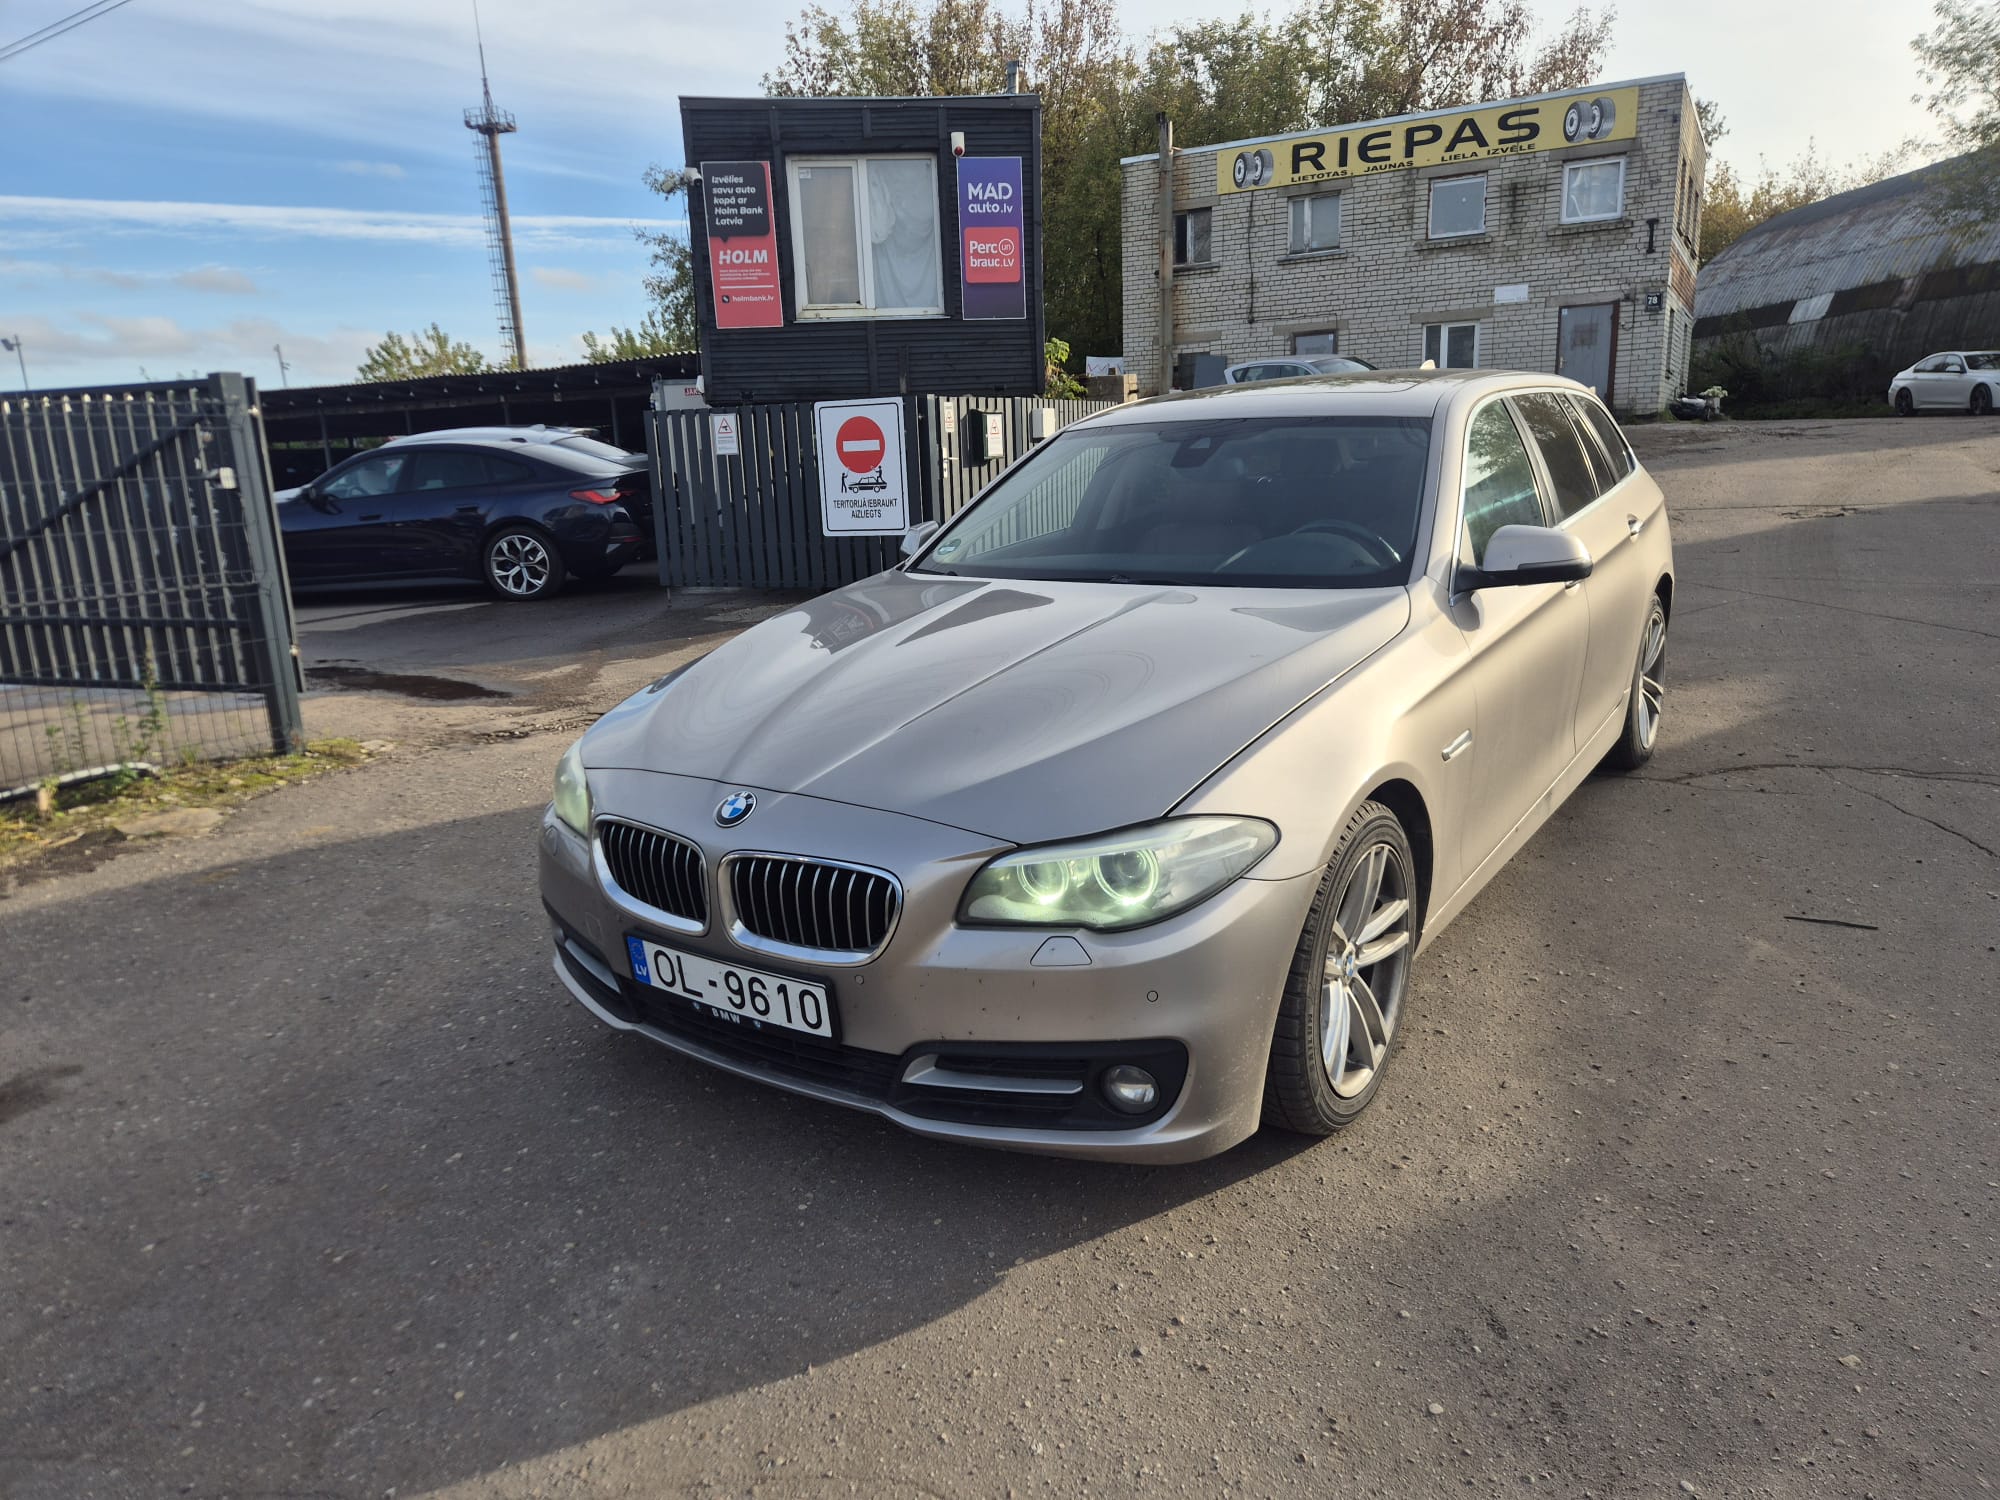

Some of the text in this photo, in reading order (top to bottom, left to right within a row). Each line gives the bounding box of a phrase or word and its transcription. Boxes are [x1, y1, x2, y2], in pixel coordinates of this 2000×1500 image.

[1292, 108, 1540, 174] RIEPAS
[1363, 160, 1414, 173] JAUNAS
[1441, 151, 1478, 162] LIELA
[712, 175, 744, 184] Izvēlies
[735, 186, 756, 194] auto
[968, 182, 1013, 200] MAD
[715, 206, 764, 215] Holm Bank
[968, 202, 1013, 213] auto.lv
[716, 217, 743, 225] Latvia
[969, 240, 998, 254] Perc
[719, 250, 768, 264] HOLM
[970, 256, 1014, 267] brauc.LV
[1647, 296, 1658, 305] 78
[868, 498, 897, 508] IEBRAUKT
[851, 509, 882, 518] AIZLIEGTS
[634, 963, 648, 977] LV
[653, 949, 823, 1030] OL-9610
[711, 1007, 741, 1025] BMW
